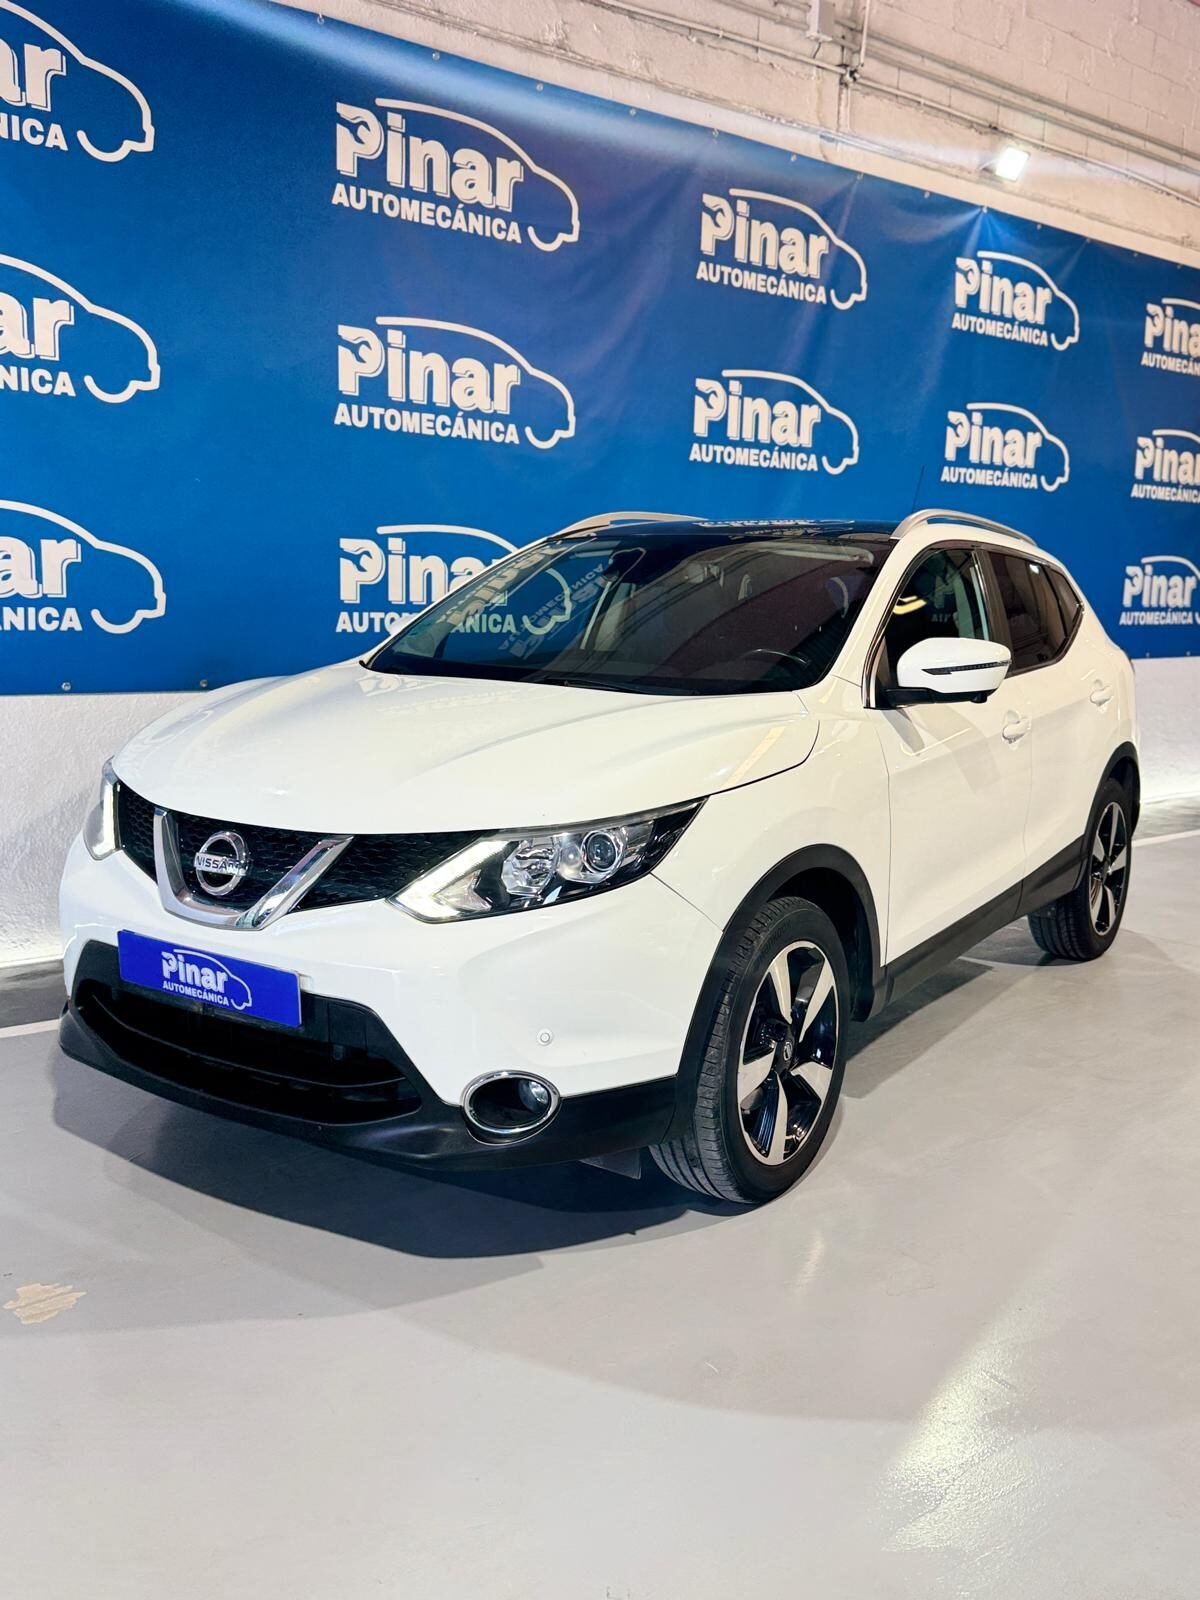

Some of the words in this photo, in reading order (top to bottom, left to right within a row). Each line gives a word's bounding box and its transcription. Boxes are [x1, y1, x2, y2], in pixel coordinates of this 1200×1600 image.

[335, 101, 524, 213] Pinar
[331, 182, 522, 245] AUTOMECÁNICA
[700, 192, 829, 280] Pinar
[695, 260, 827, 304] AUTOMECÁNICA
[954, 256, 1052, 325] Pinar
[951, 312, 1049, 347] AUTOMECÁNICA
[337, 324, 521, 415] Pinar
[333, 402, 520, 445] AUTOMECÁNICA
[693, 377, 821, 448] Pinar
[688, 442, 818, 472] AUTOMECÁNICA
[944, 410, 1042, 469] Pinar
[940, 466, 1038, 489] AUTOMECÁNICA
[1122, 564, 1197, 609] Pinar
[1119, 607, 1194, 626] AUTOMECÁNICA
[161, 951, 229, 994] Pinar
[162, 980, 230, 1007] AUTOMECÁNICA
